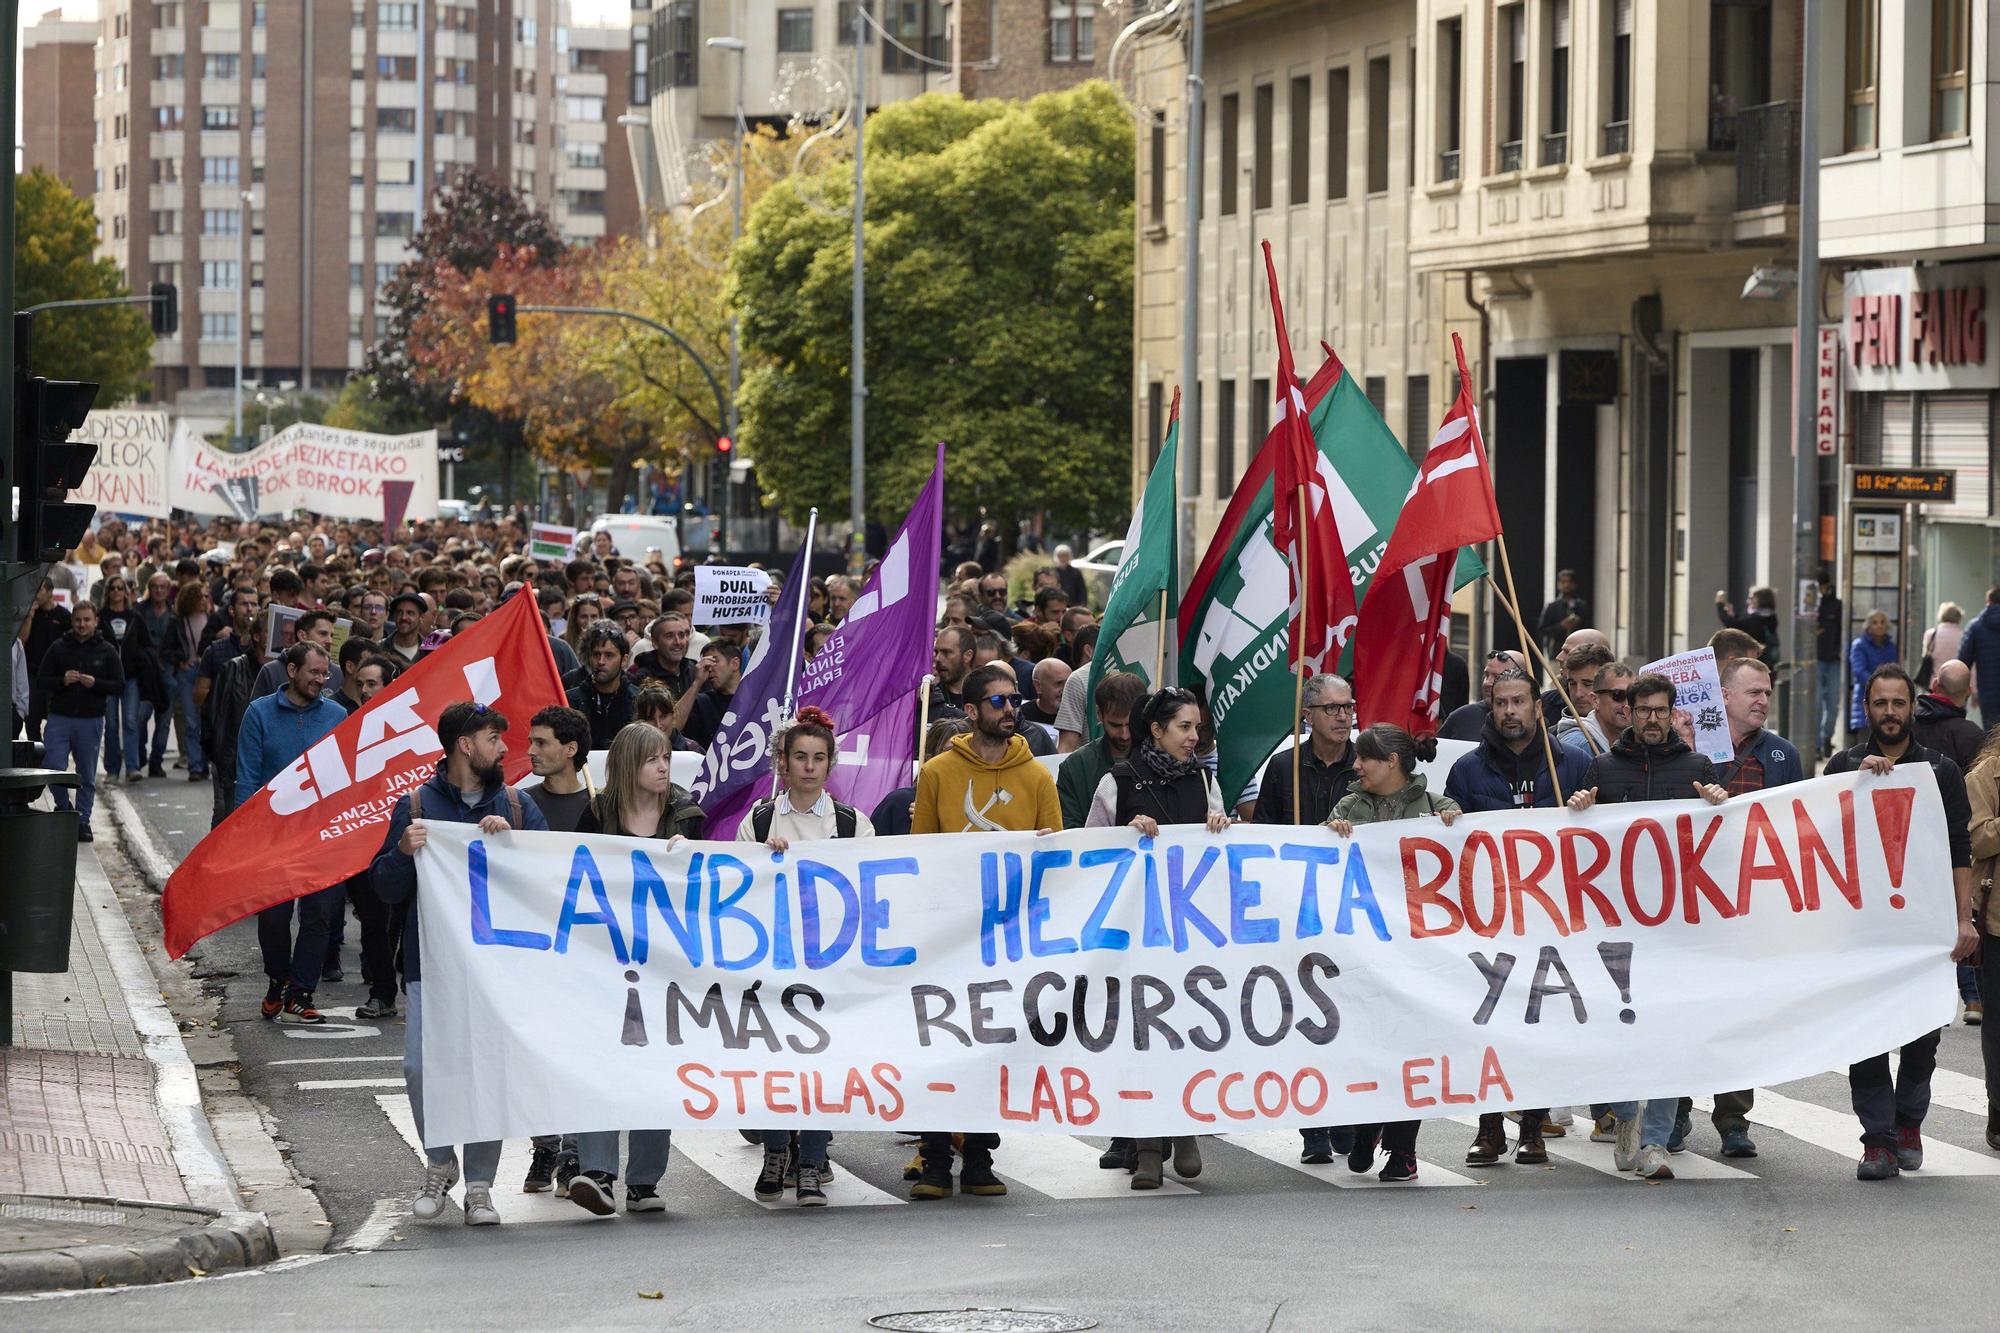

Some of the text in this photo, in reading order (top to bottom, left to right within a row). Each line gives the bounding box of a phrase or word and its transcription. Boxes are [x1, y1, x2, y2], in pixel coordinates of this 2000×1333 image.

[1851, 286, 1985, 368] FEN FANG
[67, 471, 160, 506] OKAN!!!
[701, 595, 769, 606] INPROBISAZIO
[720, 580, 757, 594] DUAL
[1674, 691, 1711, 707] ELGA
[1400, 786, 1915, 939] BORROKAN!
[621, 941, 1637, 1055] ¡MÁS RECURSOS YA!
[677, 1063, 904, 1121] STEILAS
[1000, 1065, 1100, 1126] LAB
[1182, 1068, 1328, 1122] CCOO
[1403, 1045, 1514, 1108] ELA
